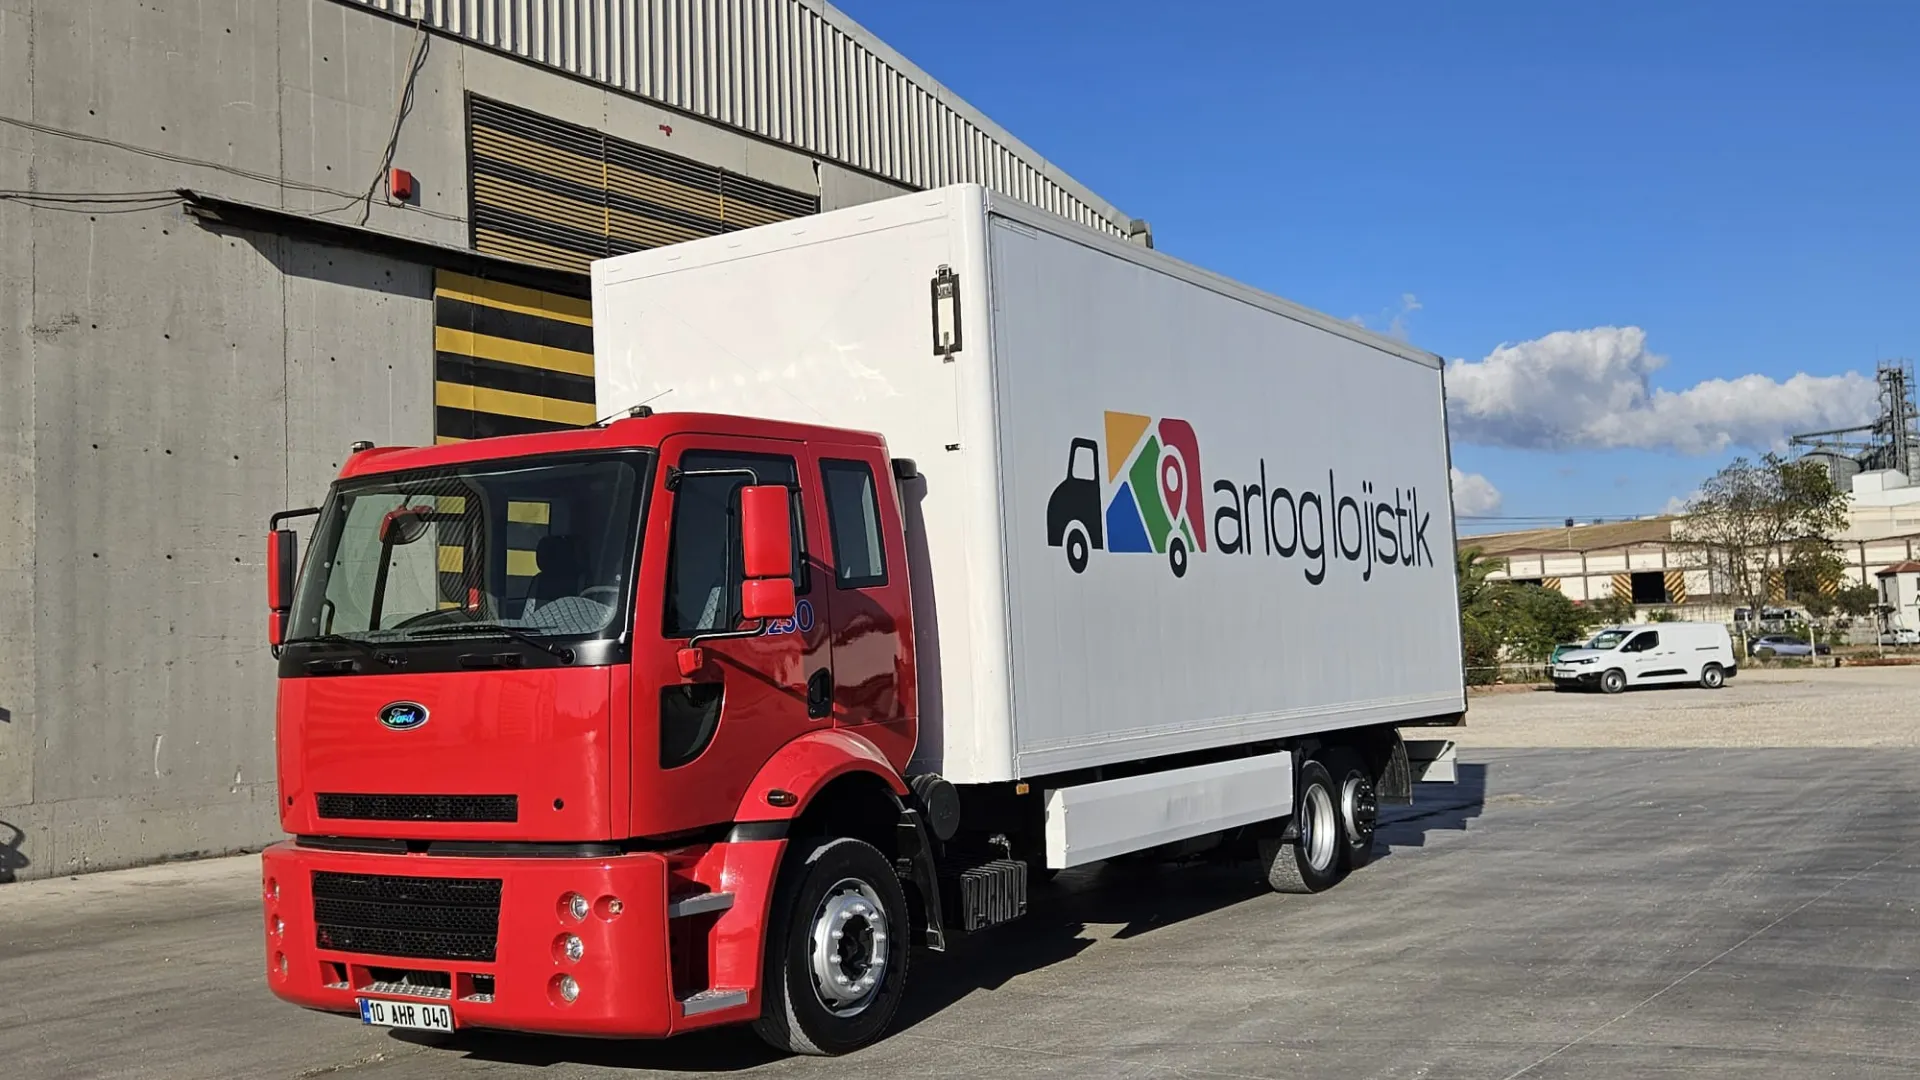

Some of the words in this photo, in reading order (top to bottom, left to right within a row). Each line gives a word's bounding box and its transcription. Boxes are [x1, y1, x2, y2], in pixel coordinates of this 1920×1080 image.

[388, 707, 416, 724] Ford
[370, 1002, 385, 1022] 10
[391, 1004, 416, 1026] AHR
[422, 1006, 448, 1028] 040
